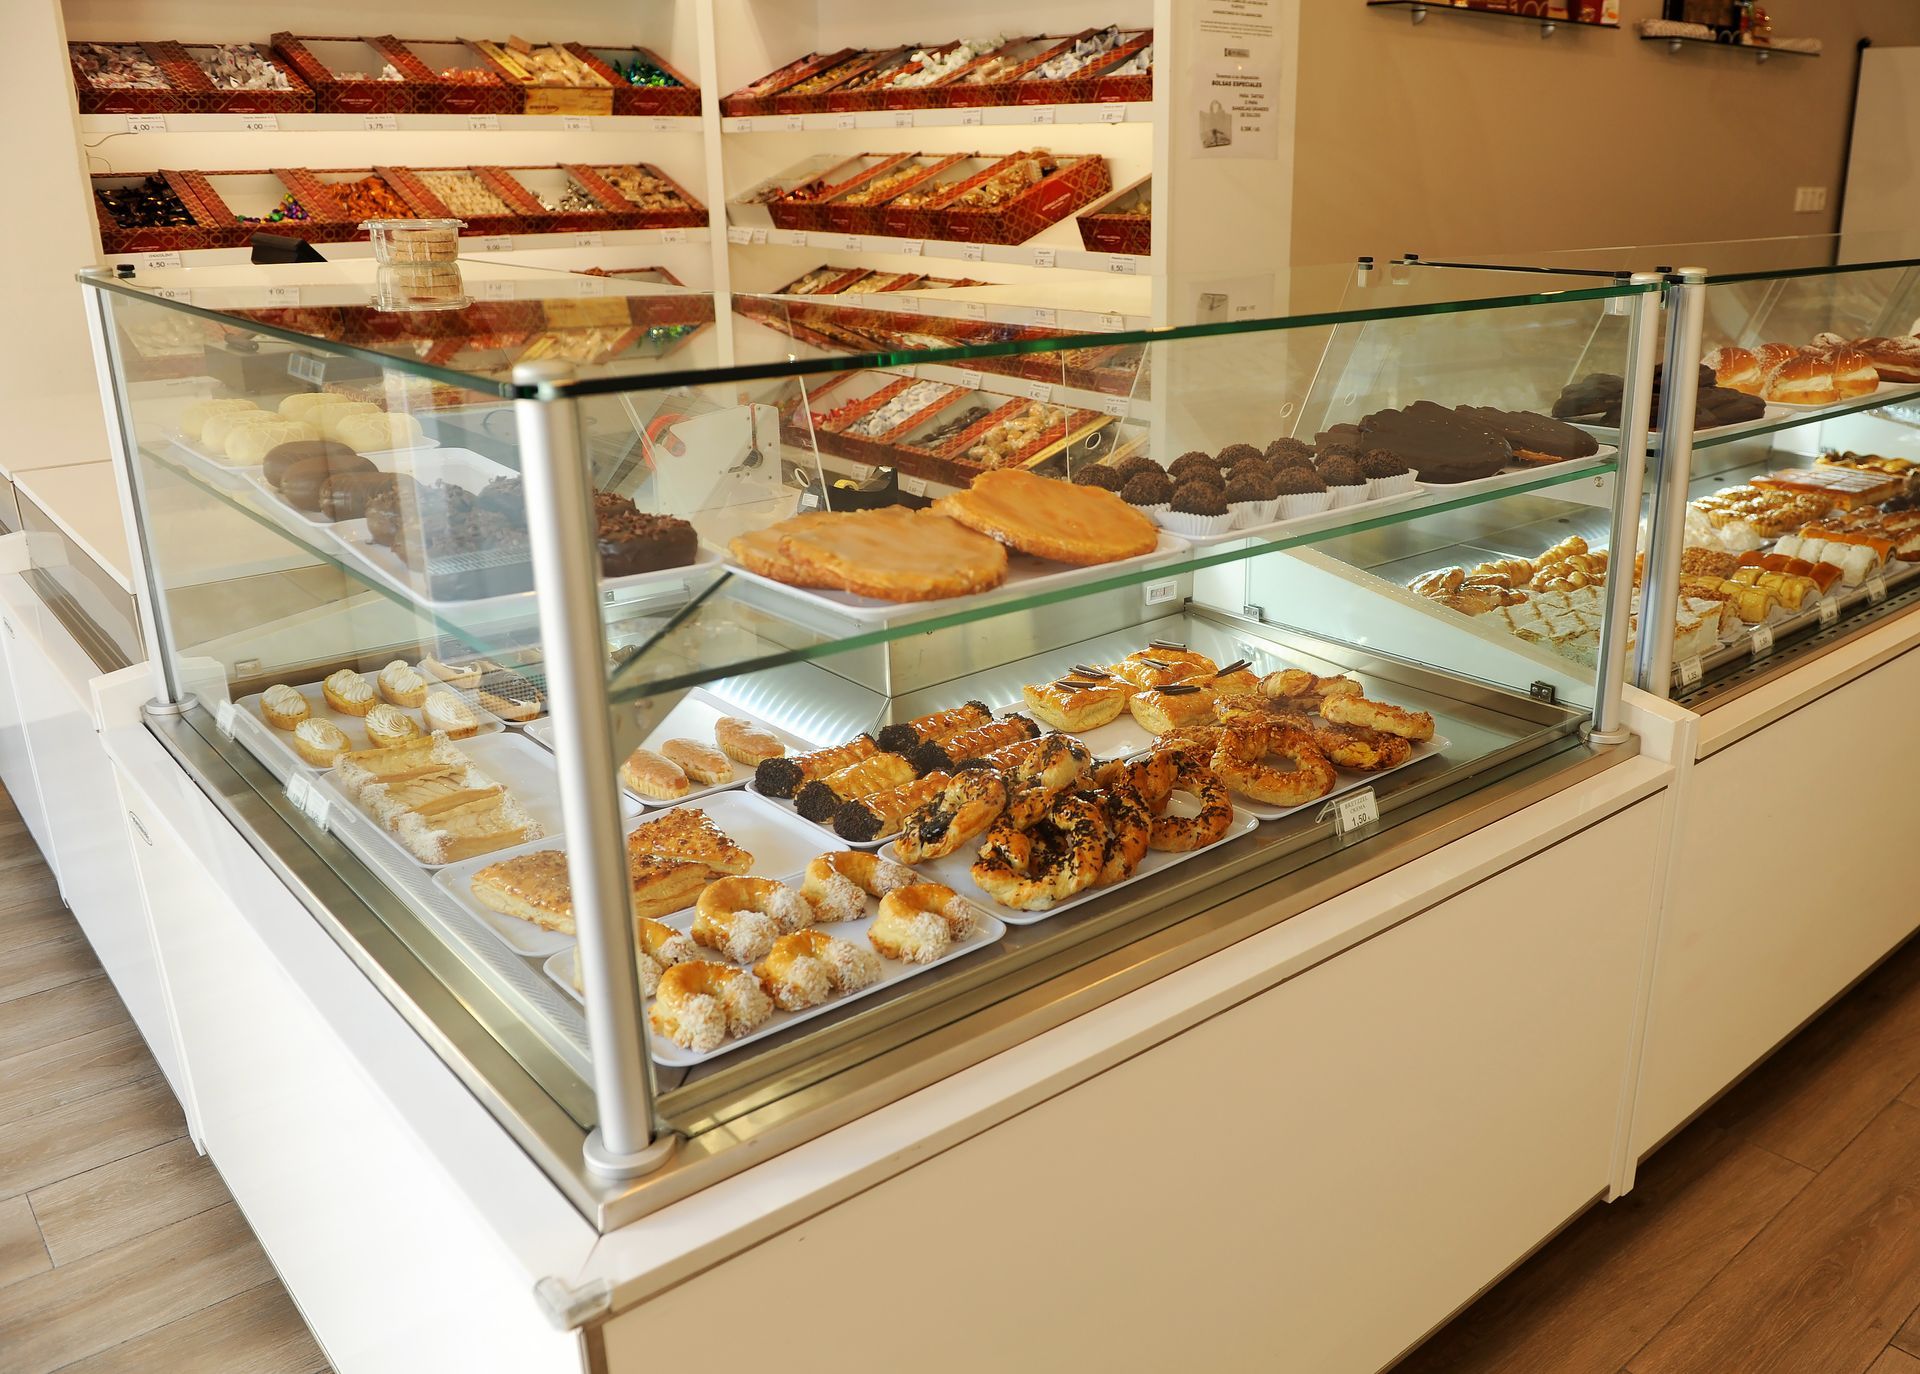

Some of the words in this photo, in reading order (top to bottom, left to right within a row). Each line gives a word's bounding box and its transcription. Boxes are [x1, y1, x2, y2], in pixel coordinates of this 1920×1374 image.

[133, 124, 150, 132] 4,00
[246, 123, 263, 131] 4,00
[149, 261, 165, 269] 4,50
[1352, 812, 1367, 827] 1,50
